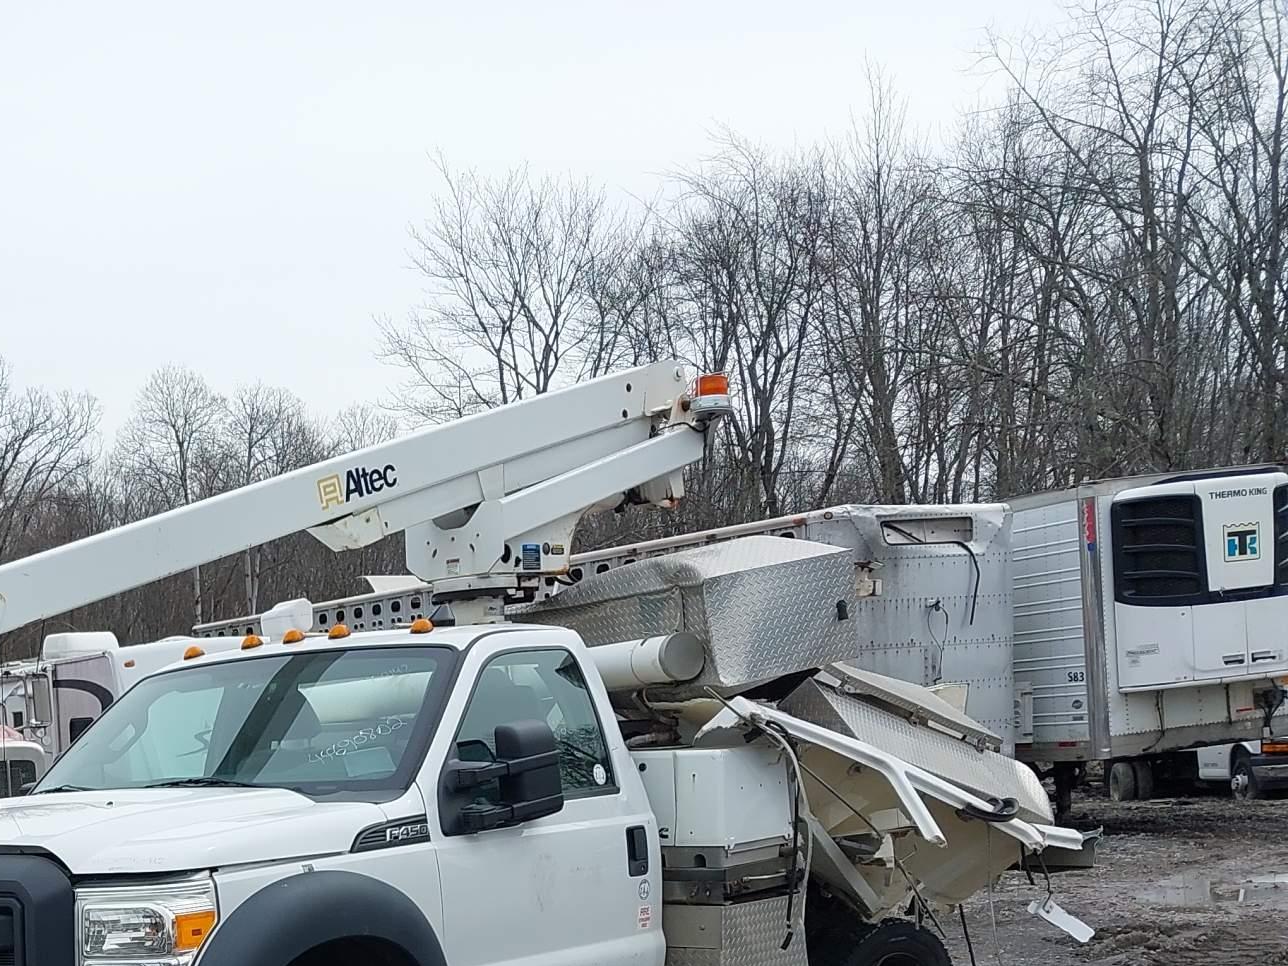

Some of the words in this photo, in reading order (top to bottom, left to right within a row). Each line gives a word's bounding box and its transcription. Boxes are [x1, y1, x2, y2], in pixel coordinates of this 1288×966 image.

[345, 464, 398, 503] Altec
[1208, 488, 1248, 500] THERMO
[1249, 487, 1268, 496] KING
